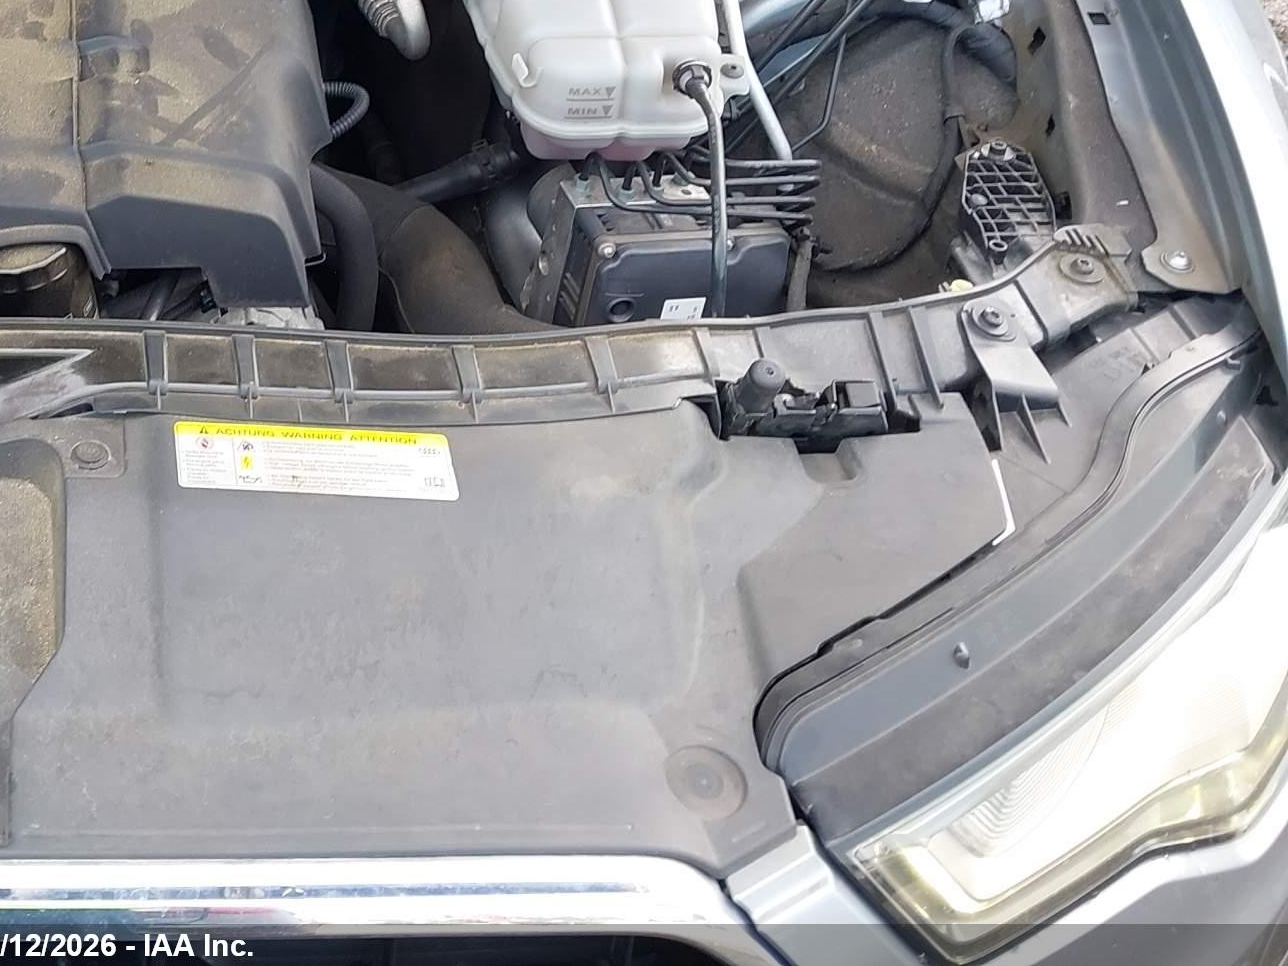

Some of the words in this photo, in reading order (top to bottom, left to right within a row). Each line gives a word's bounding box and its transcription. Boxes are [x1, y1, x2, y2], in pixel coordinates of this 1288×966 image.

[568, 86, 602, 97] MAX
[567, 106, 598, 116] MIN
[215, 427, 275, 438] ACHTUNG
[280, 431, 343, 441] WARNING
[350, 433, 417, 445] ATTENTION
